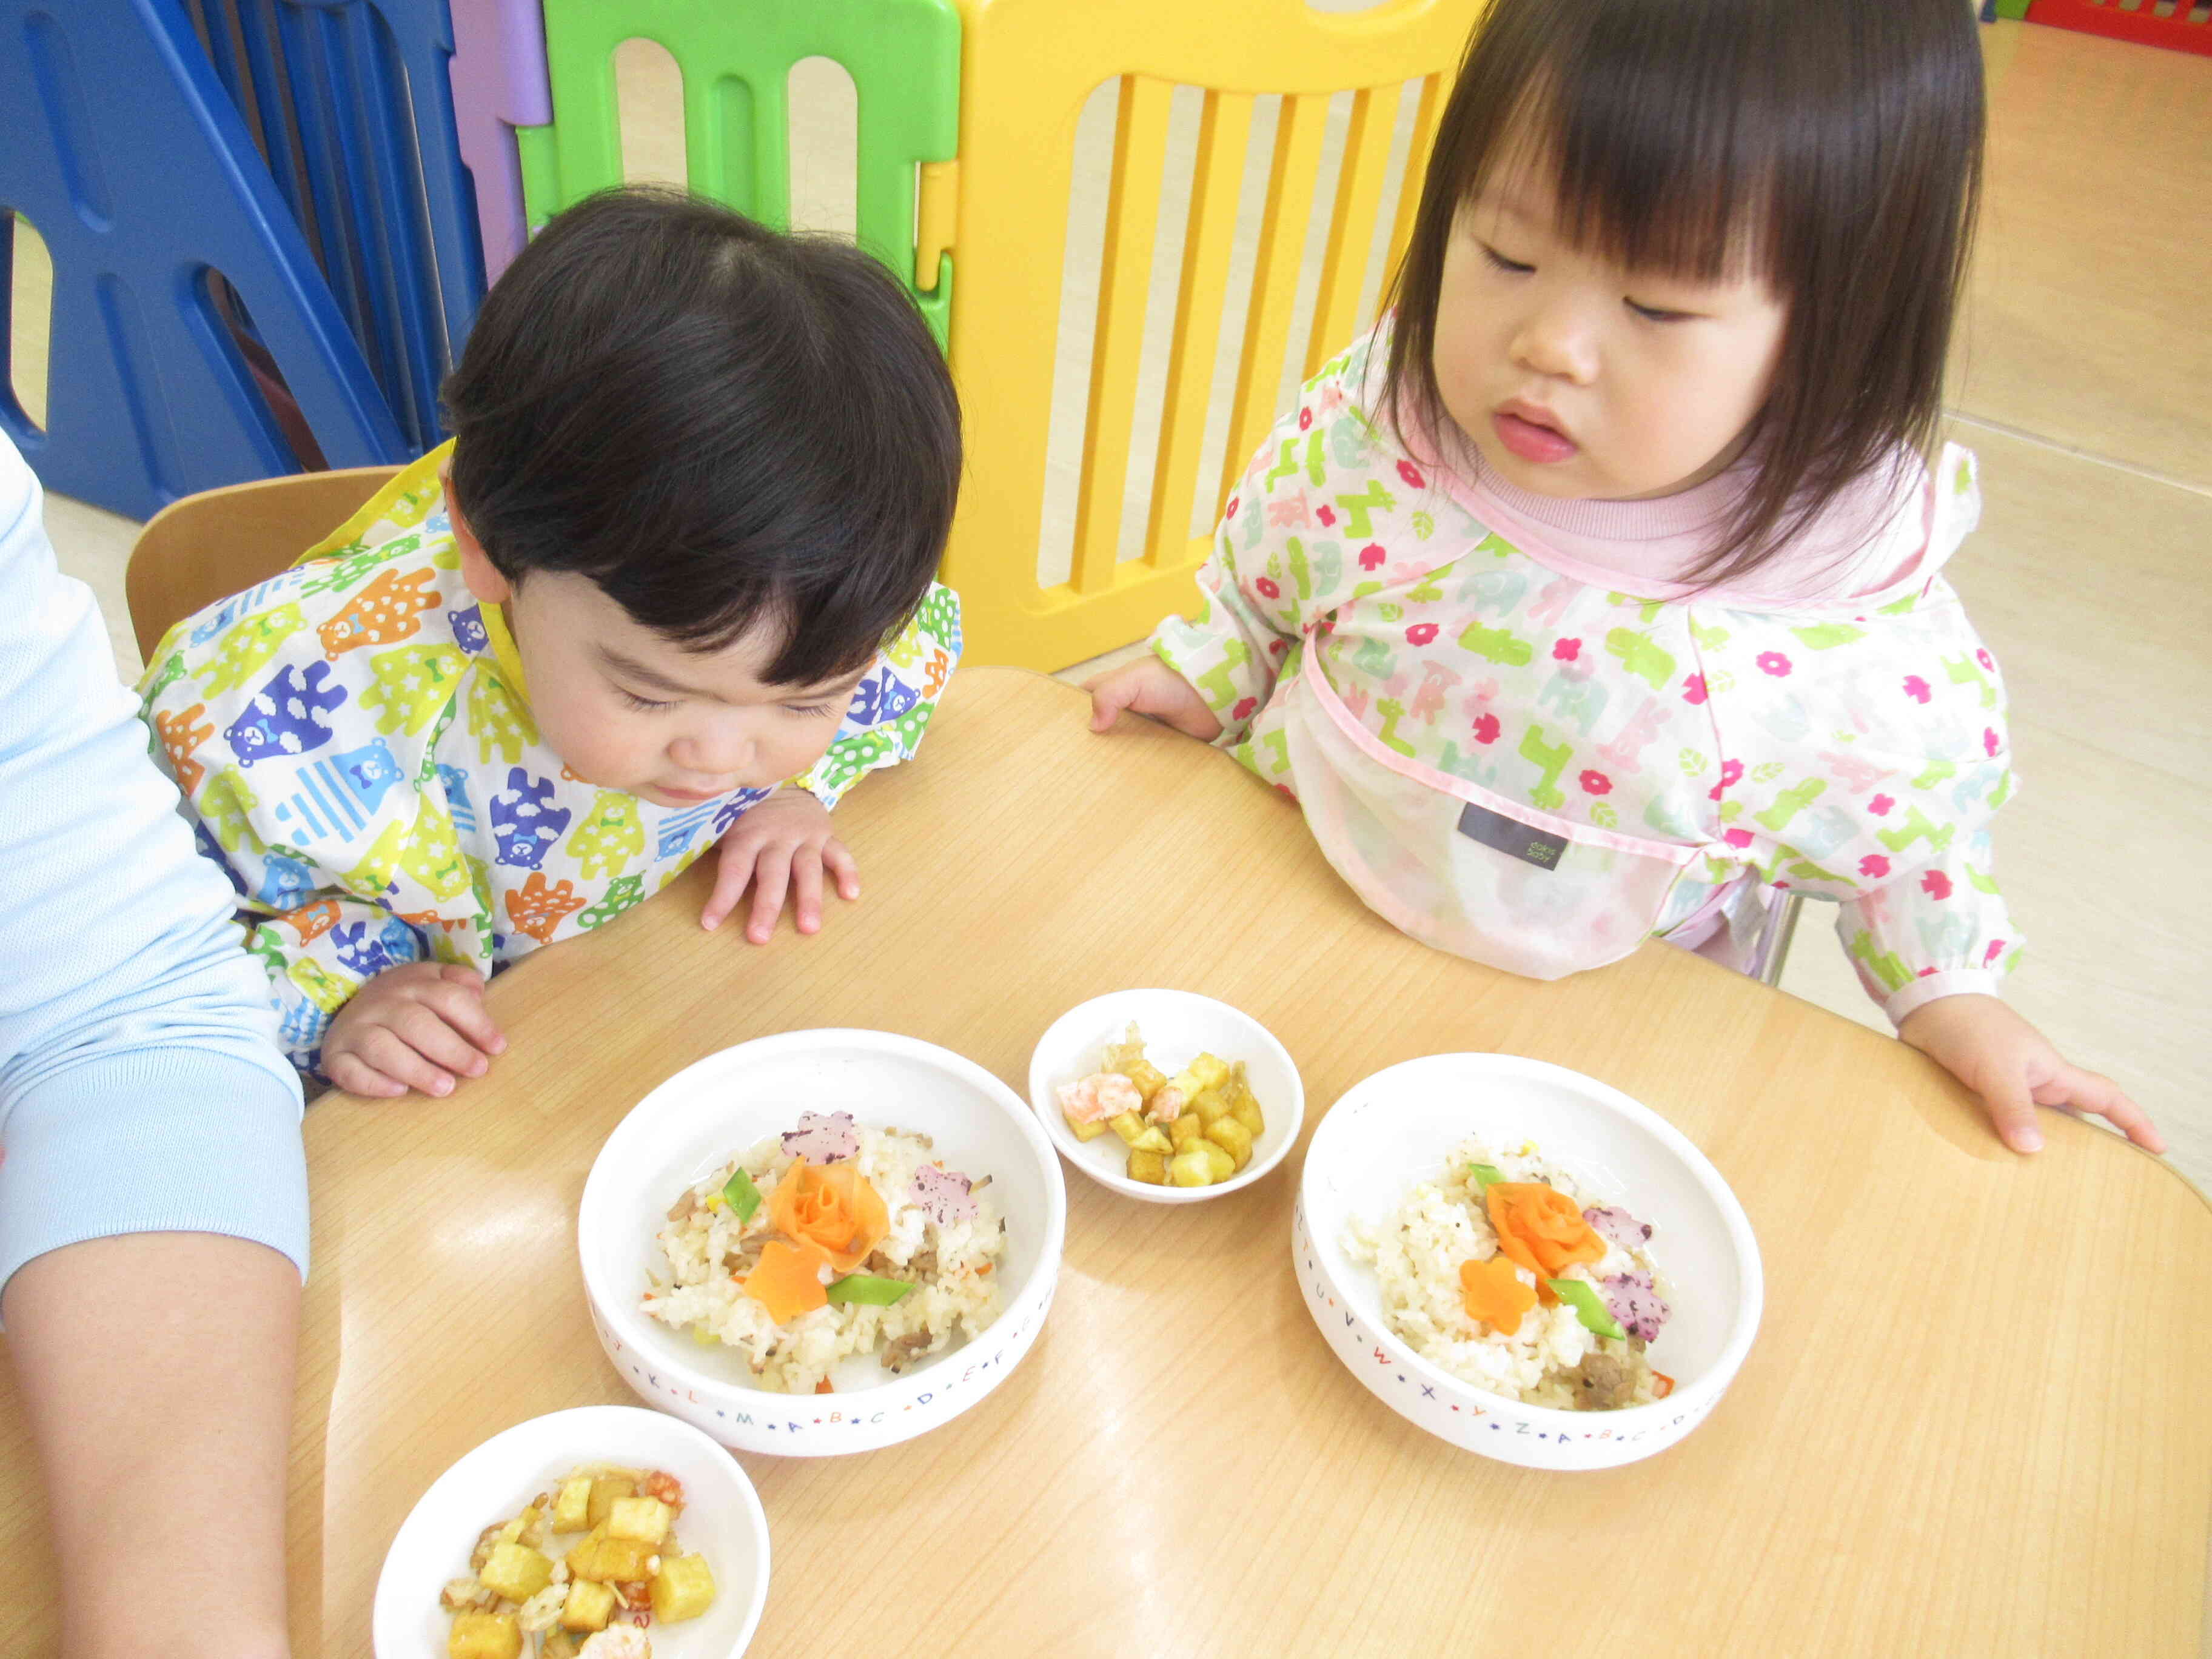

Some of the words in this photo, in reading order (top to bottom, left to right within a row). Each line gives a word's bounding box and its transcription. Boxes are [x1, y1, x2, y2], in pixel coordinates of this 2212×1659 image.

[648, 1373, 660, 1389] K
[688, 1389, 699, 1404] L
[736, 1412, 754, 1426] M
[788, 1421, 803, 1433] A
[830, 1411, 842, 1423] B
[870, 1411, 885, 1423] C
[917, 1392, 933, 1405] D
[962, 1366, 976, 1382] E
[994, 1348, 1004, 1365] F
[1345, 1310, 1355, 1327] V
[1373, 1346, 1392, 1365] W
[1421, 1383, 1436, 1401] X
[1472, 1405, 1487, 1416] Y
[1515, 1422, 1530, 1435] Z
[1558, 1432, 1572, 1444] A
[1599, 1428, 1613, 1439] B
[1631, 1430, 1647, 1442] C
[1672, 1414, 1686, 1426] D
